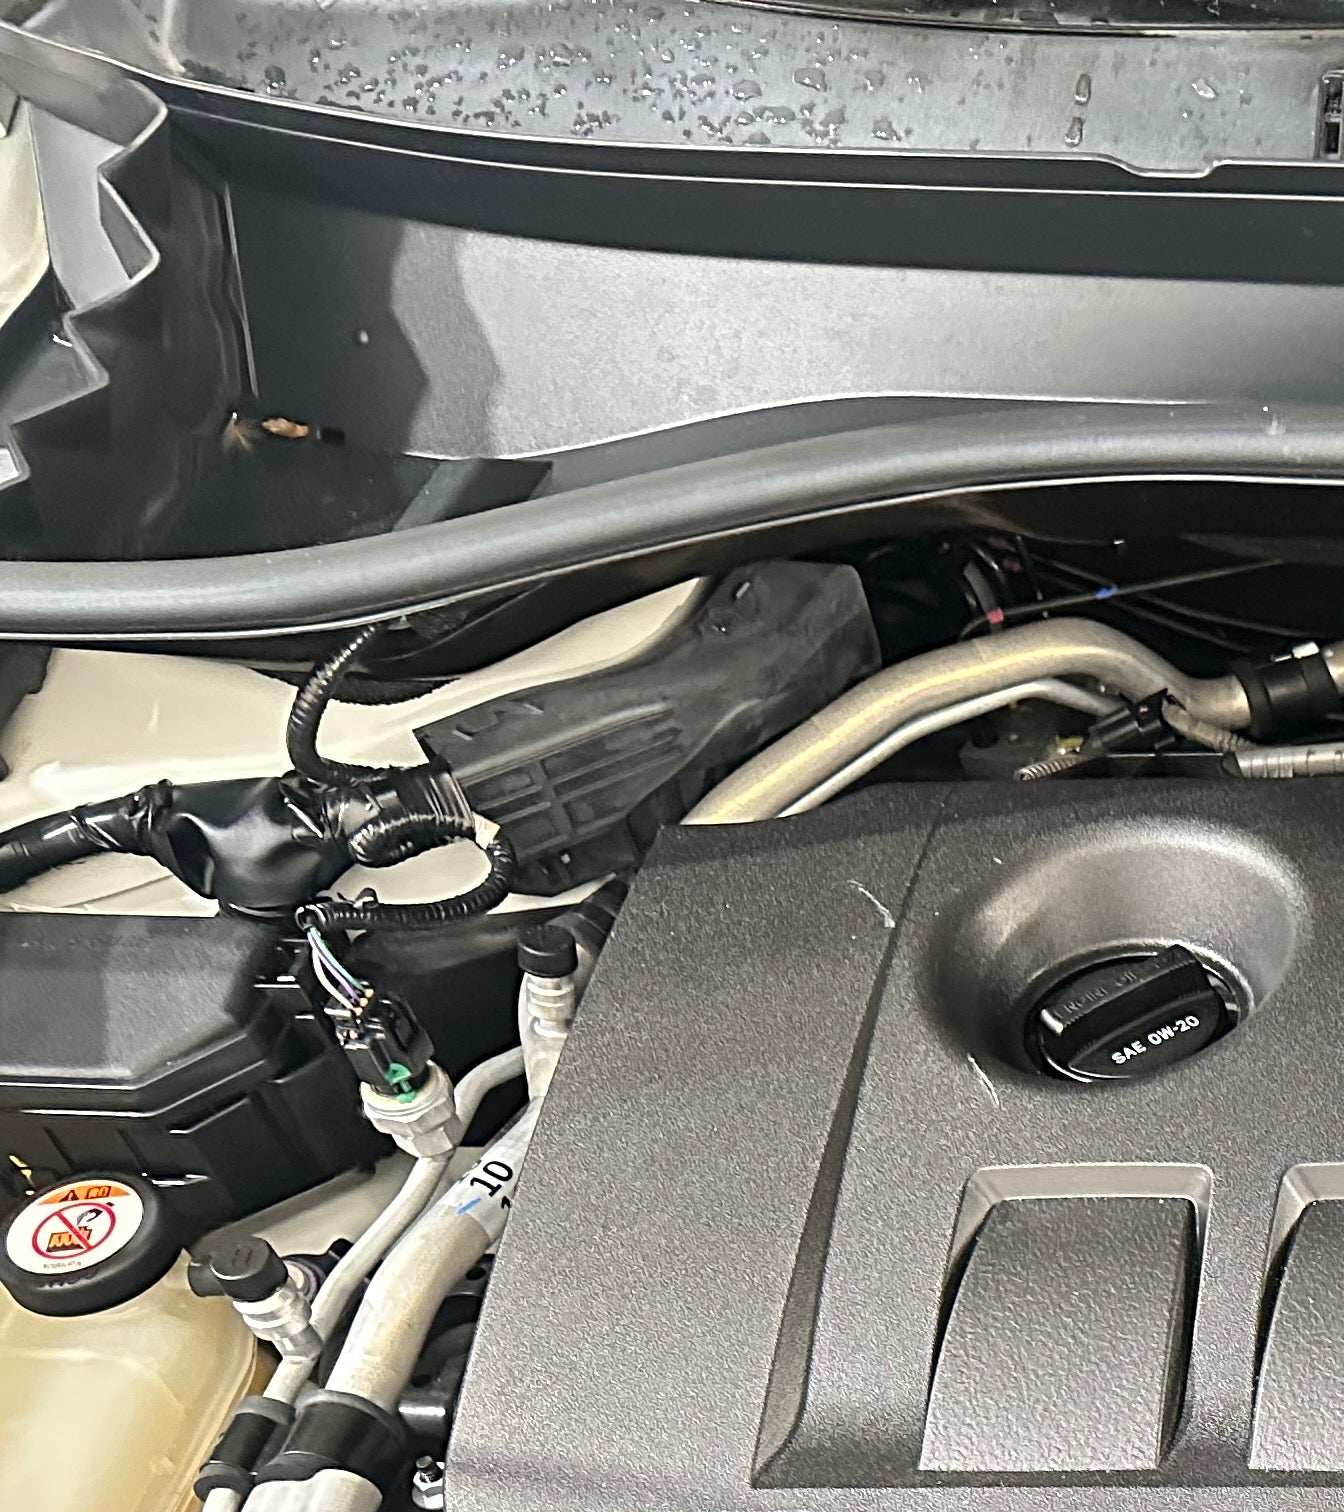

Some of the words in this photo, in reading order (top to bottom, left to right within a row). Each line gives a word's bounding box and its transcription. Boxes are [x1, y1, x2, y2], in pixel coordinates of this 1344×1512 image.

[1112, 1040, 1147, 1064] SAE
[1147, 1015, 1200, 1045] 0W-20
[470, 1161, 513, 1197] 10
